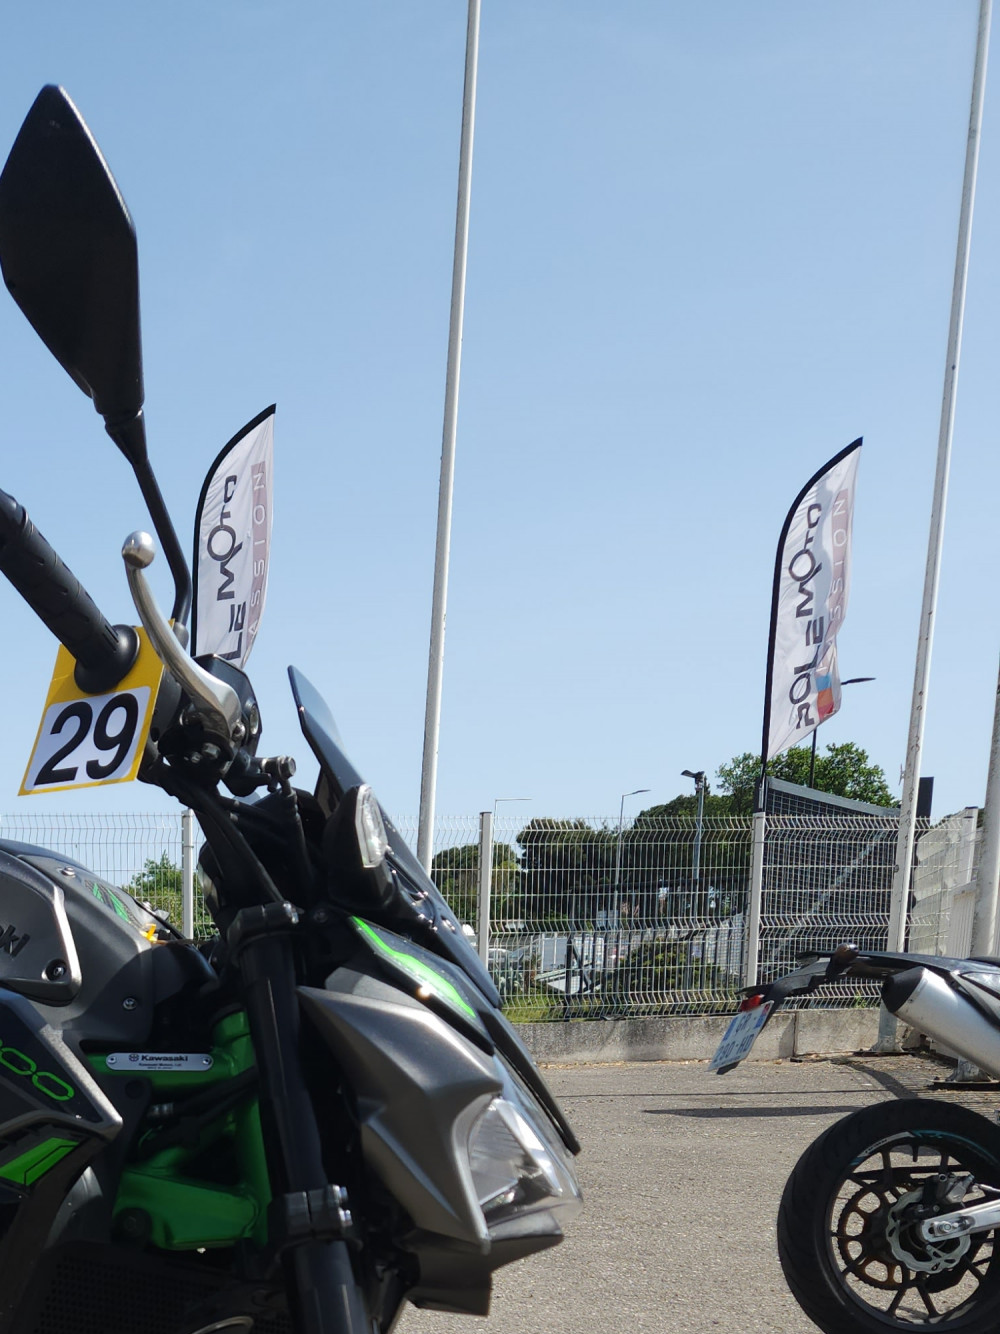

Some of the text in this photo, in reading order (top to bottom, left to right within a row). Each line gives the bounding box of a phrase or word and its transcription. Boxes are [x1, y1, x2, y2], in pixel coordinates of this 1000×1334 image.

[247, 472, 267, 635] ASSION
[34, 693, 139, 786] 29
[141, 1054, 188, 1062] Kawasaki
